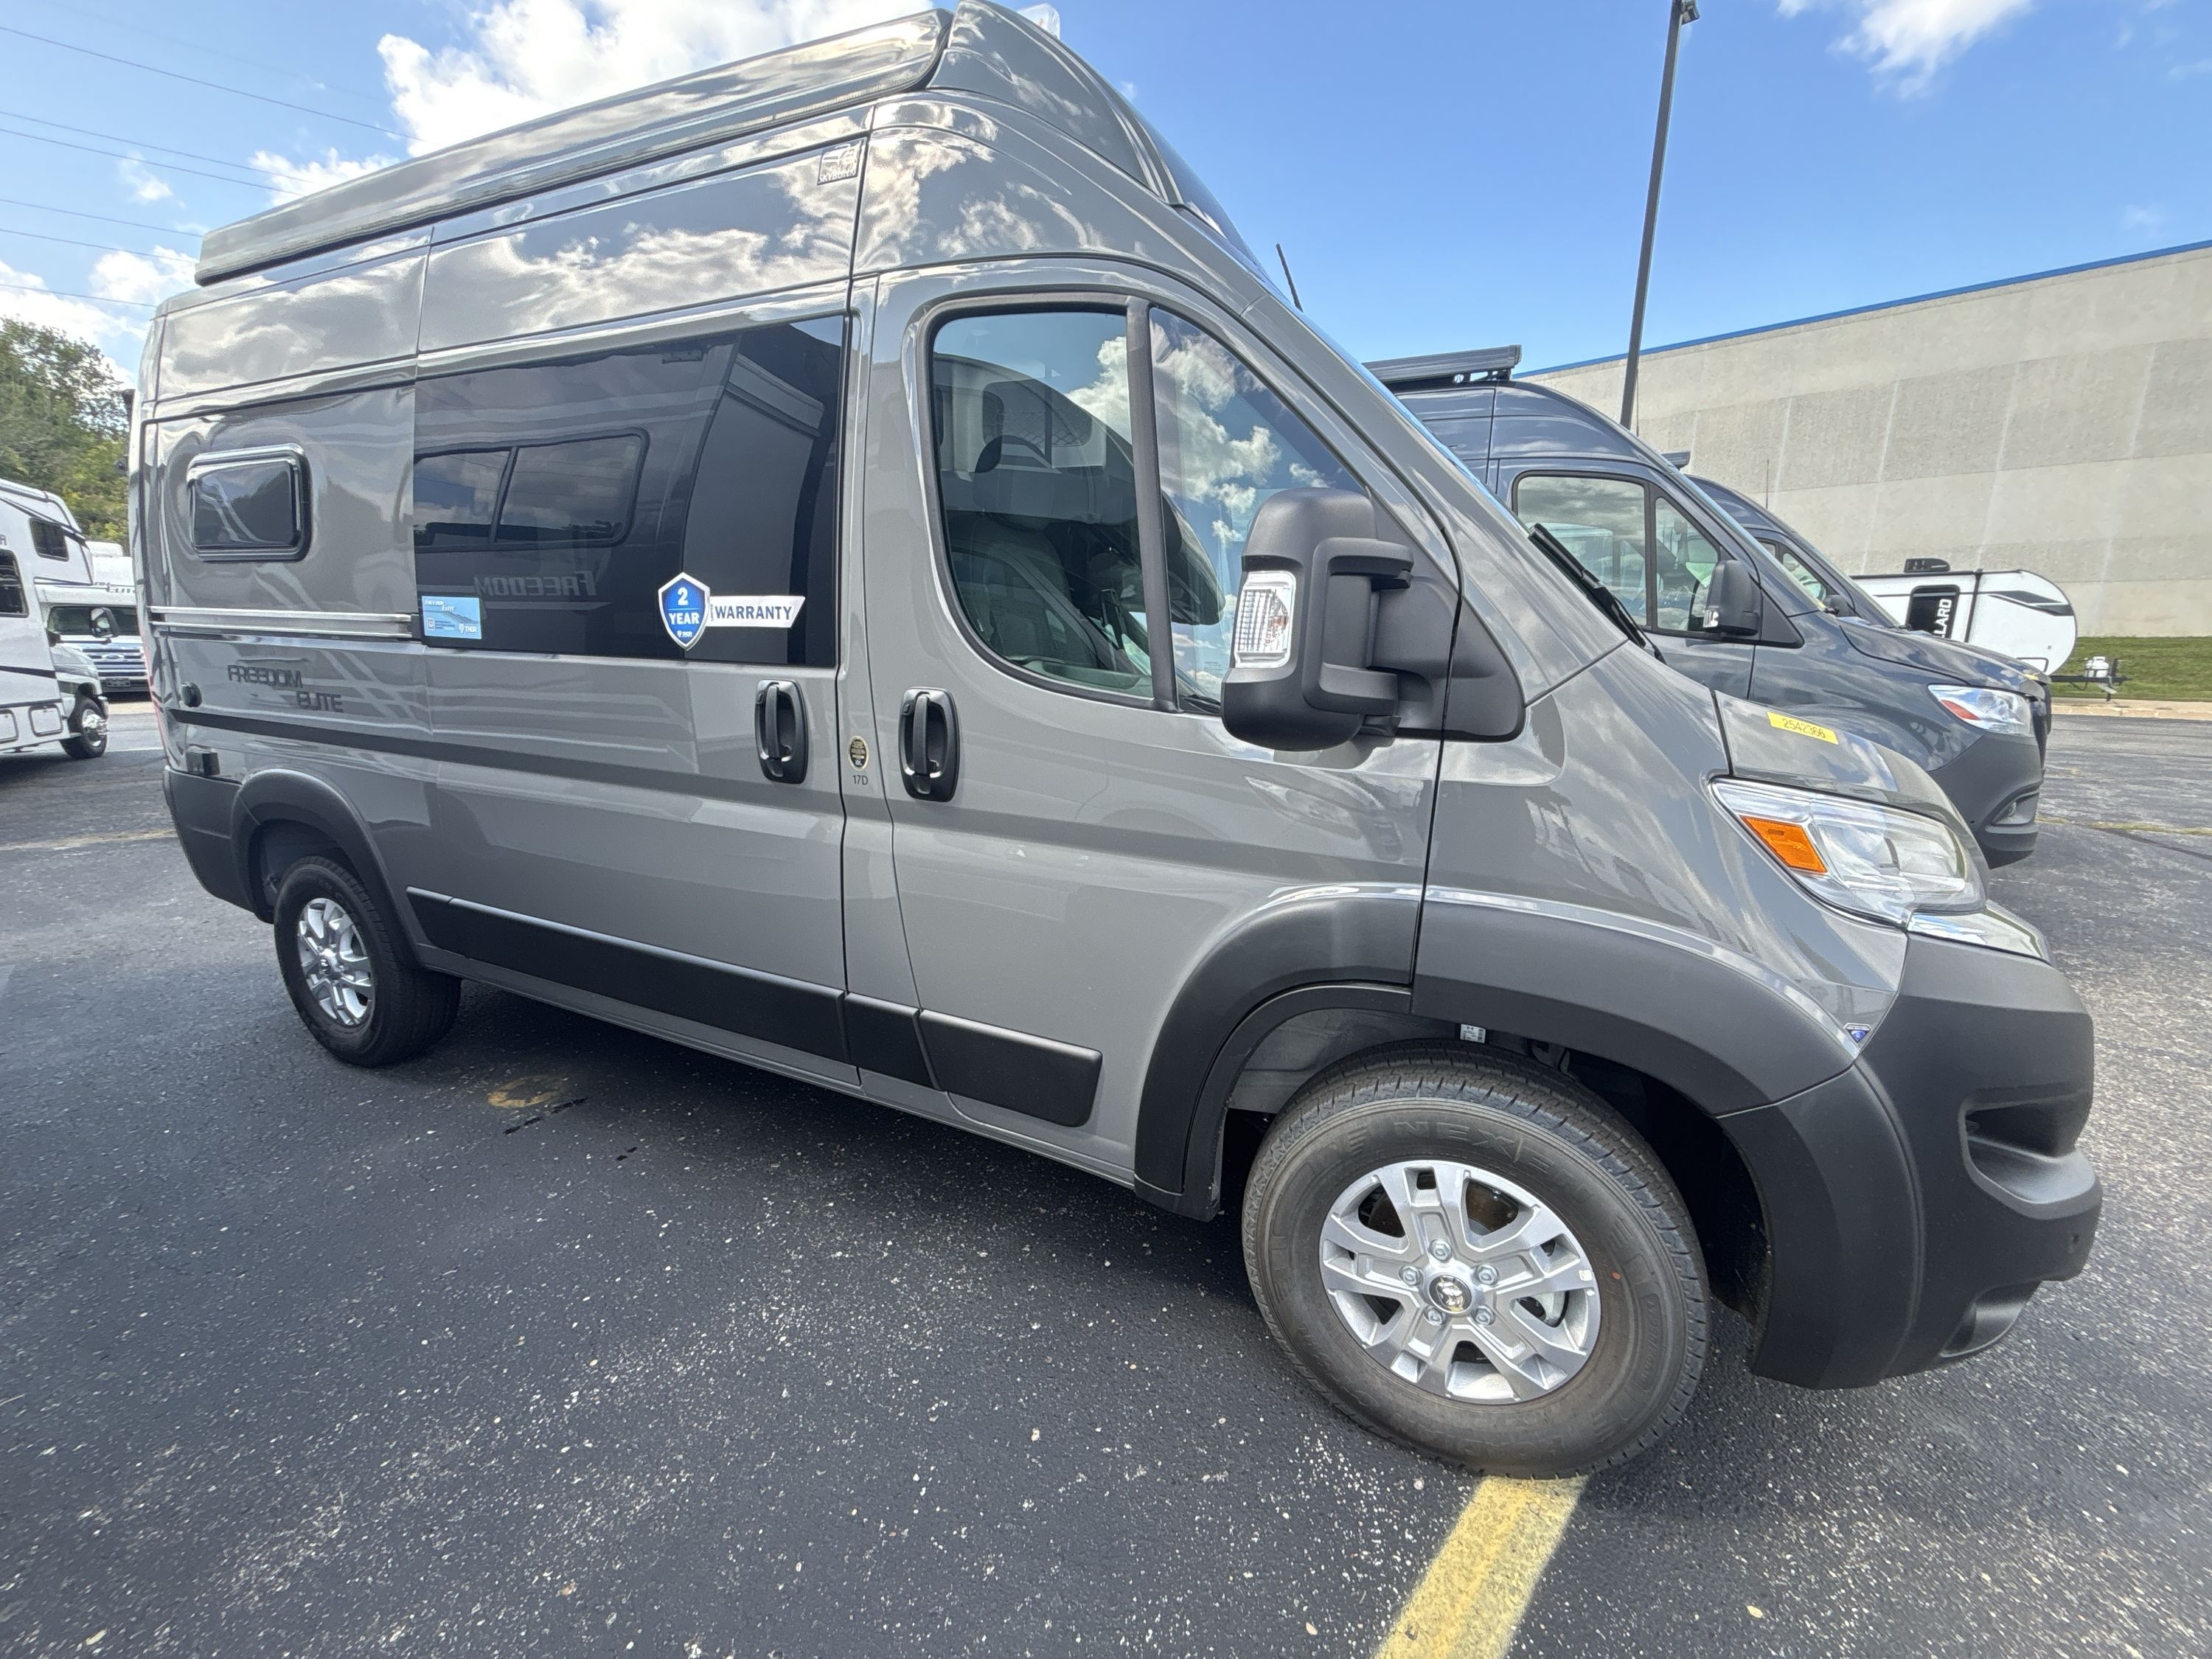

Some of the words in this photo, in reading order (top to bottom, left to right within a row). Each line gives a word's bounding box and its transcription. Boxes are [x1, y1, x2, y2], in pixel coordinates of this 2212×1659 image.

[677, 587, 689, 606] 2
[669, 612, 700, 625] YEAR
[714, 605, 793, 620] WARRANTY
[1933, 598, 1952, 638] LARD
[227, 664, 304, 689] FREEDOM
[296, 690, 344, 713] ELITE
[852, 774, 869, 785] 17D
